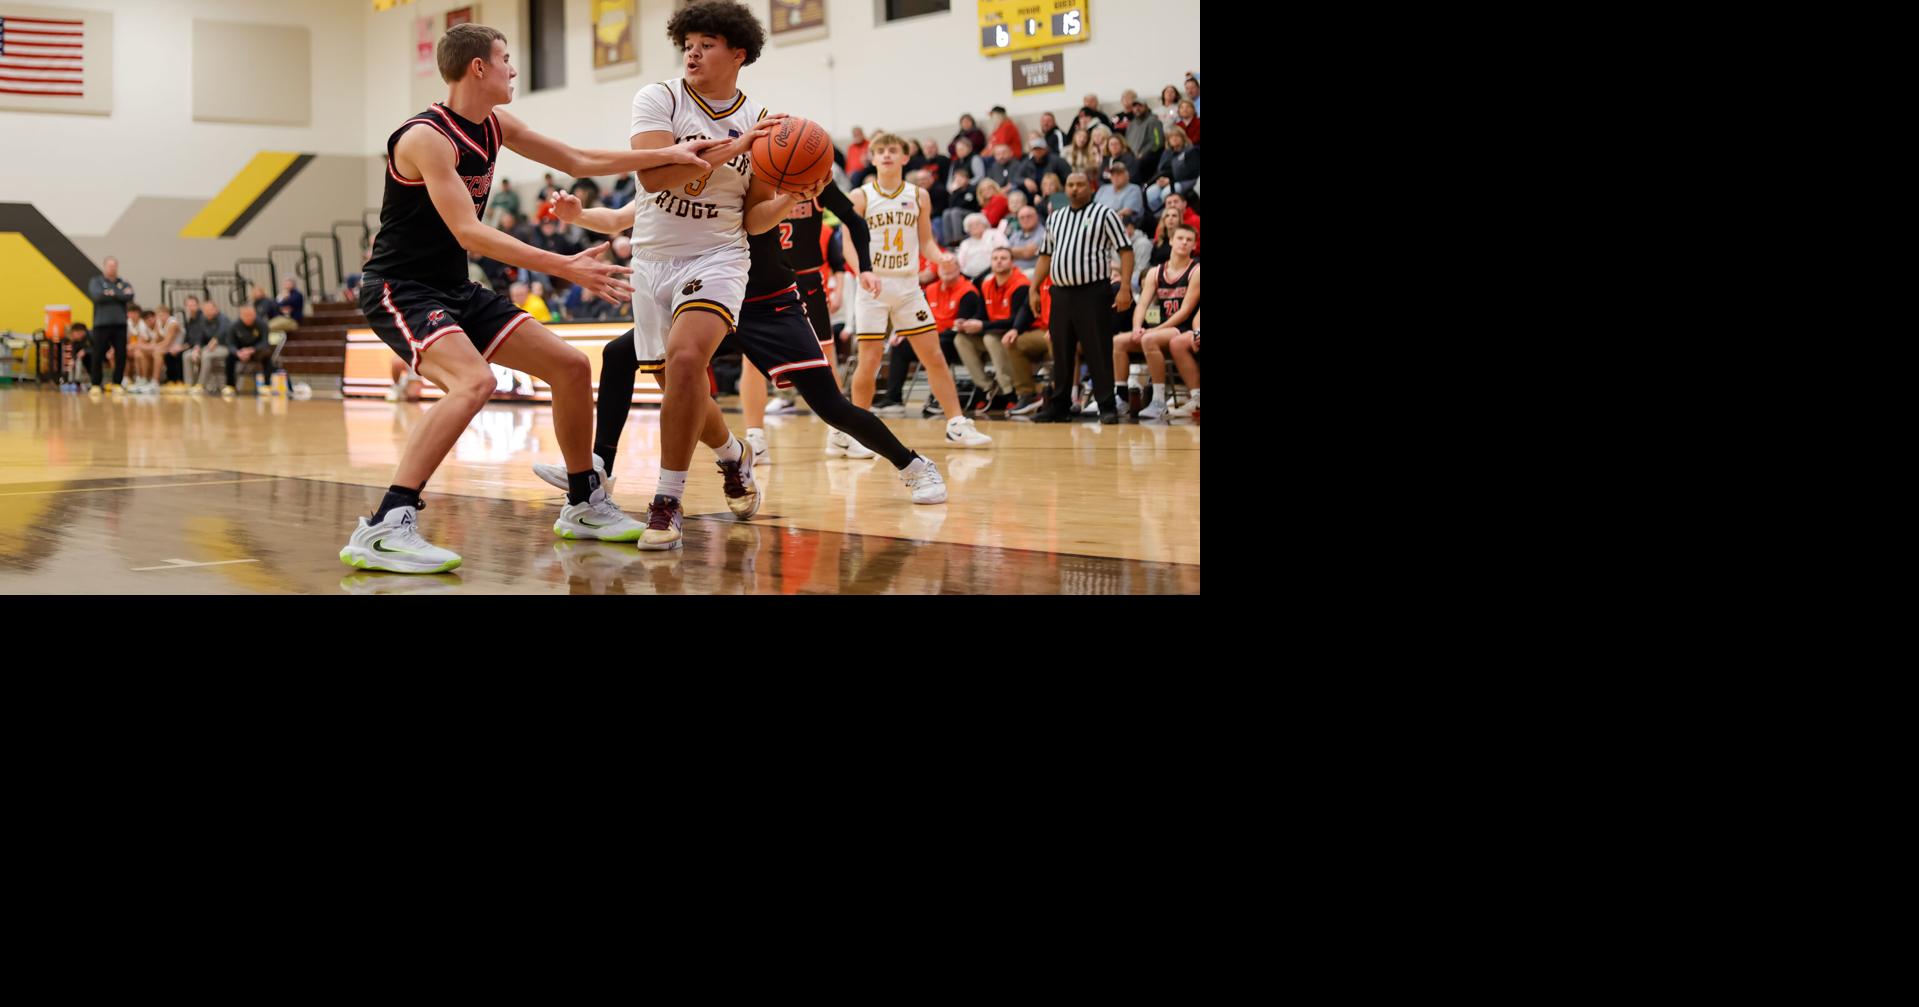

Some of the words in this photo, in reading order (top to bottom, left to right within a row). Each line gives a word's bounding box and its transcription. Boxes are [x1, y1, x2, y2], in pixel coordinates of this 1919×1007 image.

[1029, 18, 1035, 35] 1
[1063, 10, 1080, 35] 15
[655, 190, 719, 219] RIDGE
[779, 222, 793, 250] 2
[882, 227, 904, 252] 14
[873, 252, 909, 269] RIDGE
